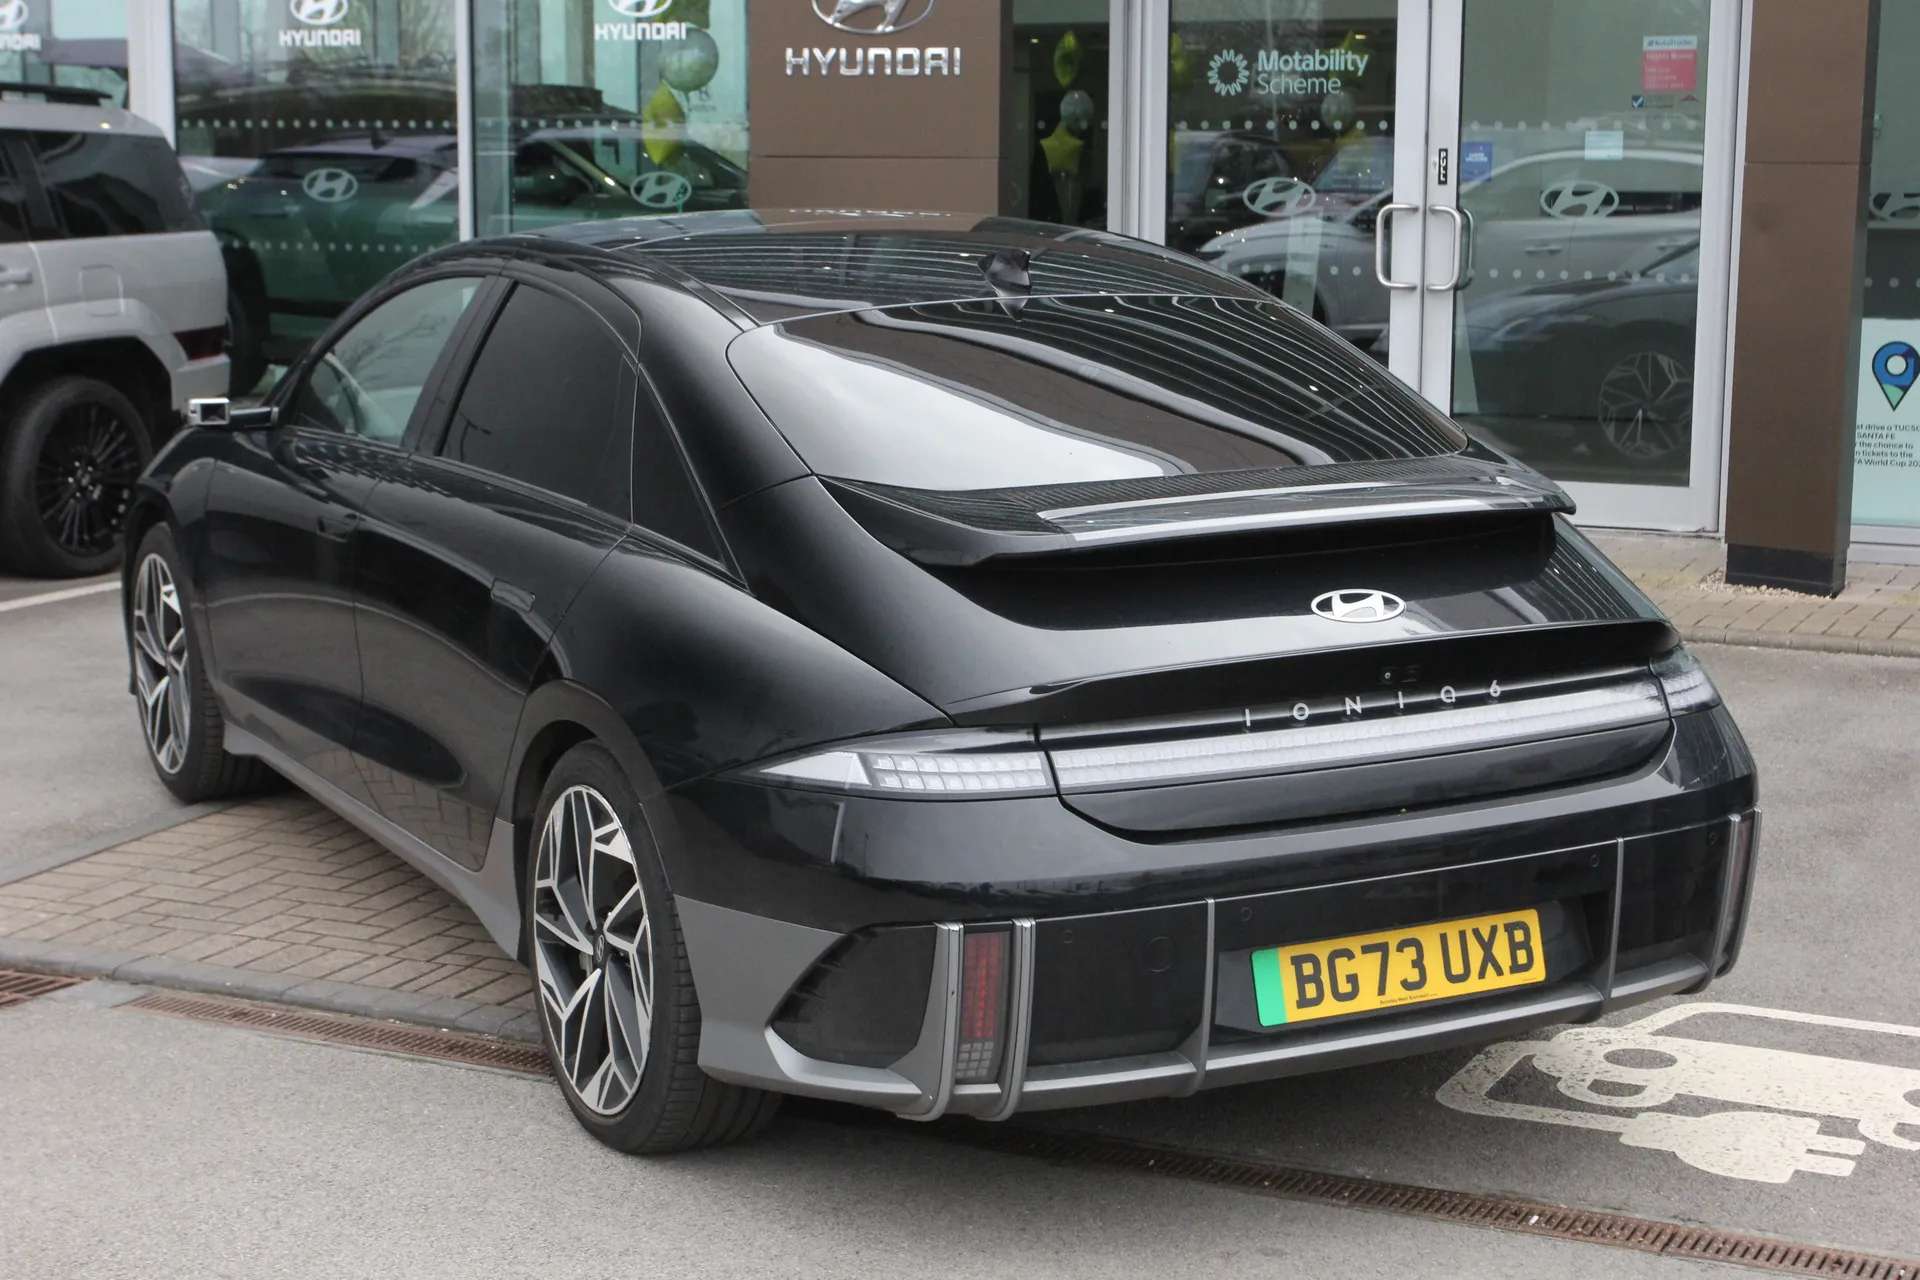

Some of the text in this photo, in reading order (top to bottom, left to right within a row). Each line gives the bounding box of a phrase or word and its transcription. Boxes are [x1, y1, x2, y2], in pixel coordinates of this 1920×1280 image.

[280, 29, 361, 47] HYUNDAI
[594, 21, 687, 40] HYUNDAI
[785, 47, 961, 76] HYUNDAI
[1257, 49, 1369, 77] Motability
[1857, 432, 1884, 440] SANTA
[1859, 441, 1872, 449] the
[1873, 441, 1904, 449] chance
[1864, 458, 1889, 467] World
[1889, 459, 1907, 468] Cup
[1908, 460, 1920, 468] 20
[1290, 920, 1535, 1010] BG73 UXB
